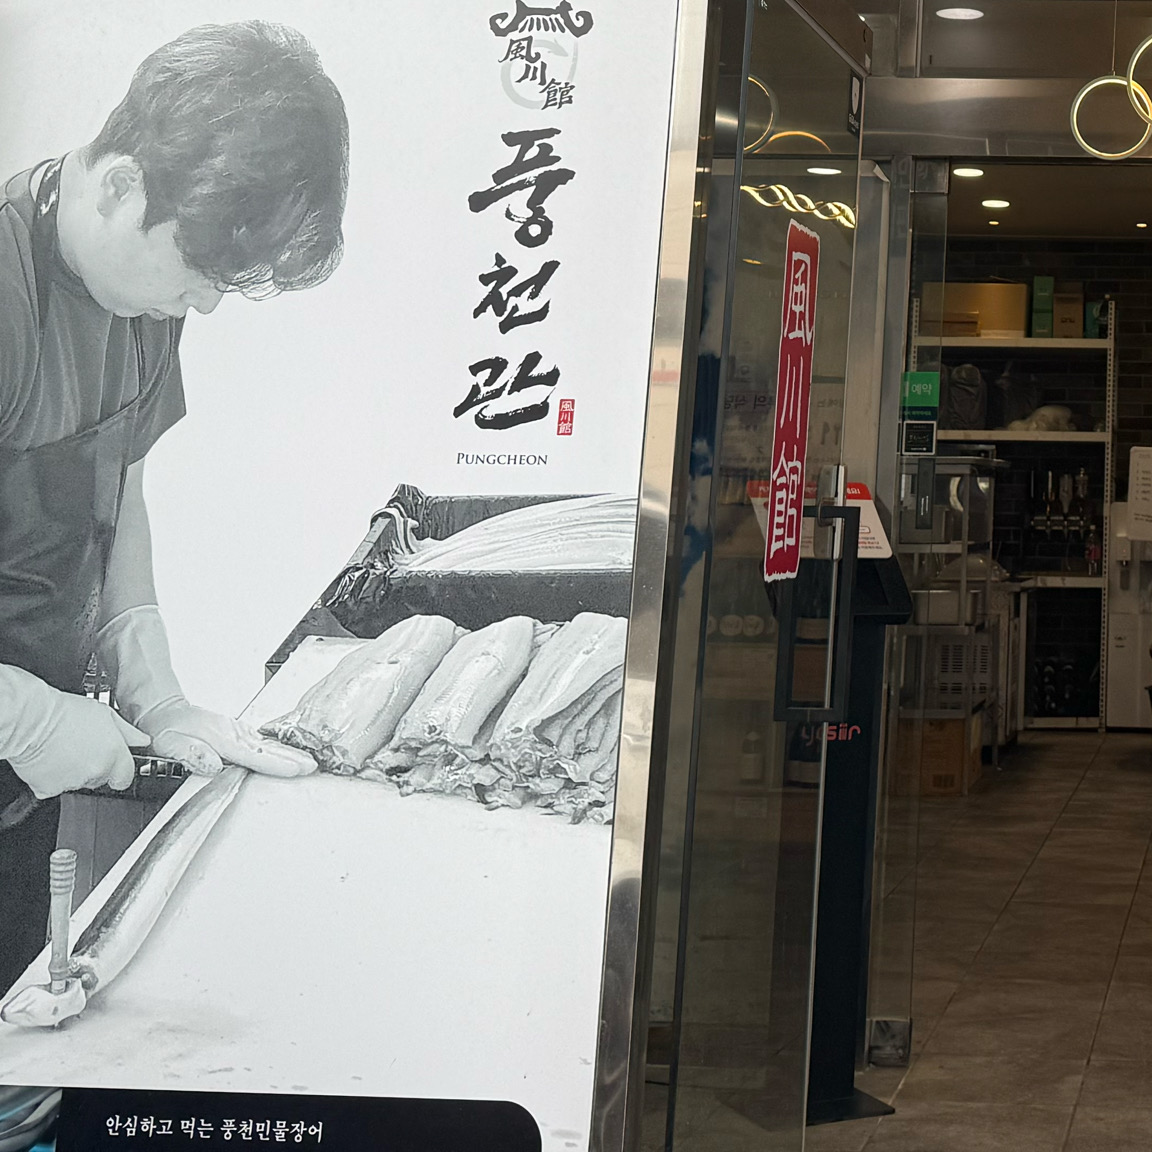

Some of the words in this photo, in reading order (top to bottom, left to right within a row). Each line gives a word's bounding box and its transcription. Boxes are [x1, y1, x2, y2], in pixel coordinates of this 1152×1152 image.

[453, 126, 575, 431] 풍천관
[911, 383, 932, 396] 예약
[107, 1115, 172, 1137] 안심하고
[181, 1118, 213, 1138] 먹는
[221, 1120, 322, 1142] 풍천민물장어
